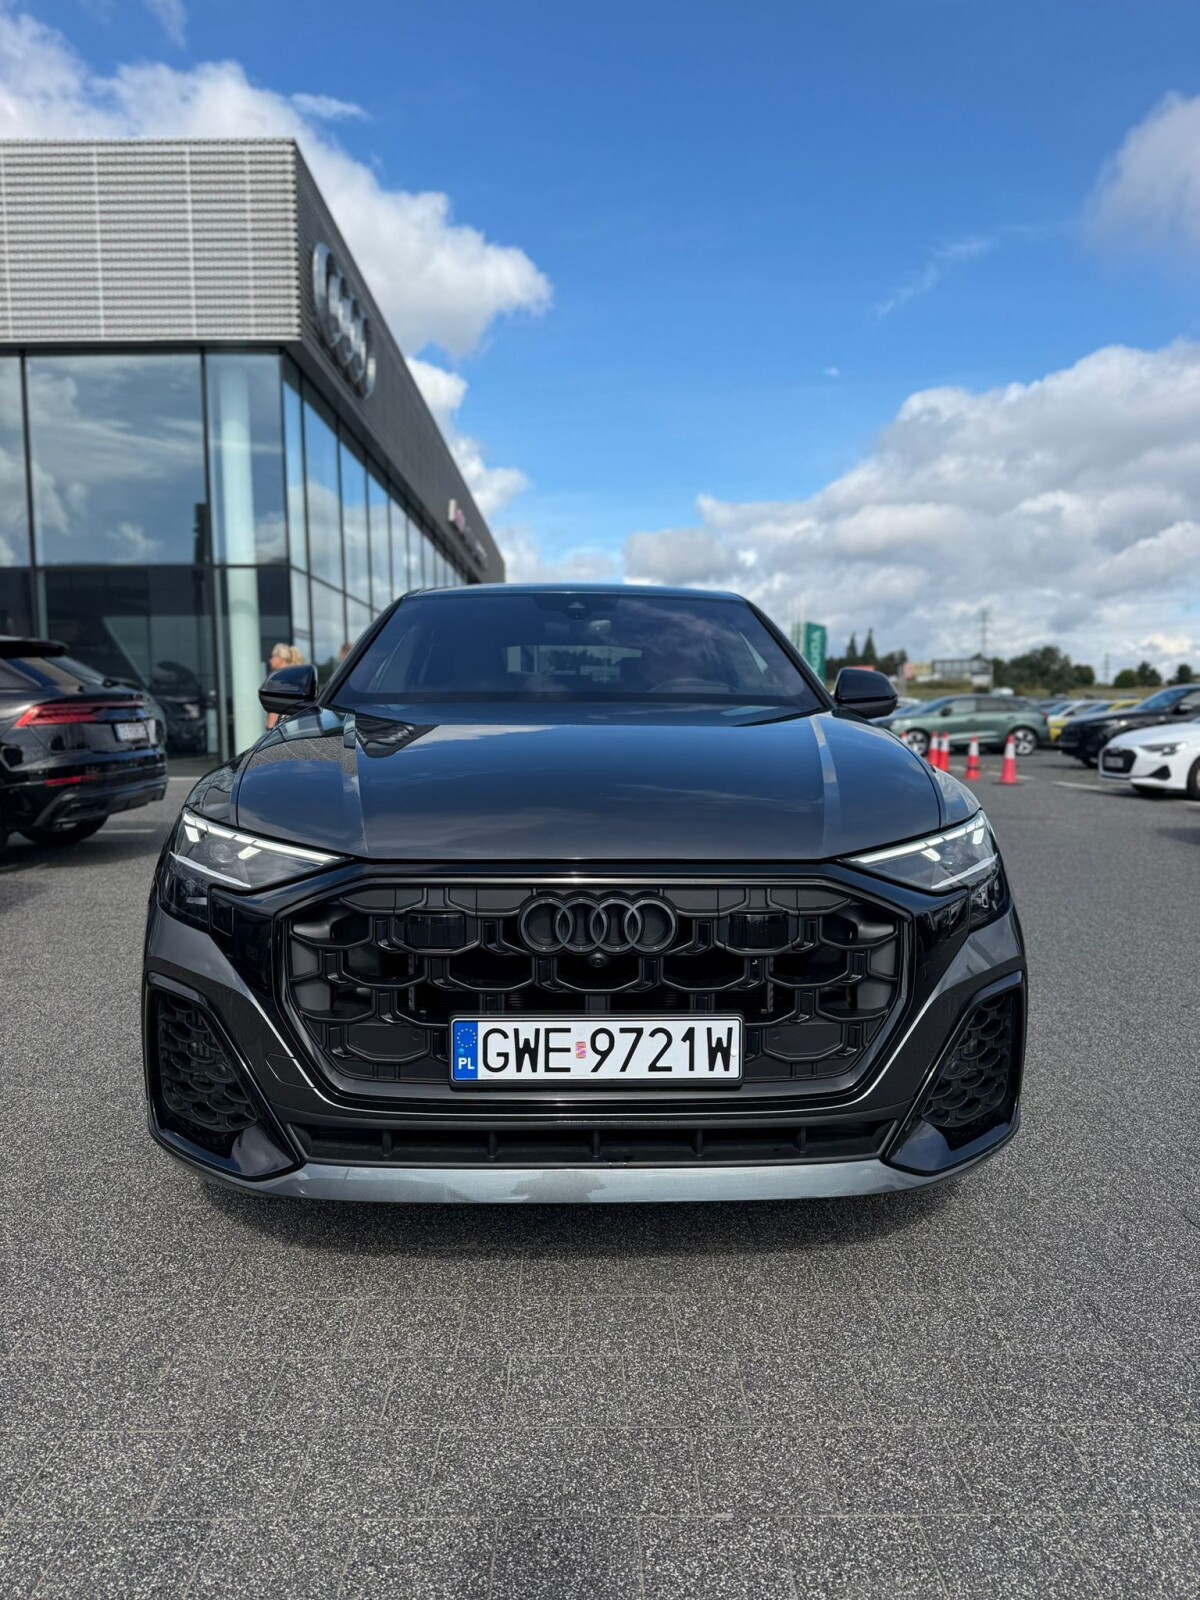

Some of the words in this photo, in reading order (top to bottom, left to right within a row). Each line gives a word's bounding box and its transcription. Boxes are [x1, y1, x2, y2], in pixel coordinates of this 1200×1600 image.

[458, 1058, 475, 1070] PL
[482, 1027, 572, 1073] GWE
[590, 1026, 733, 1073] 9721W
